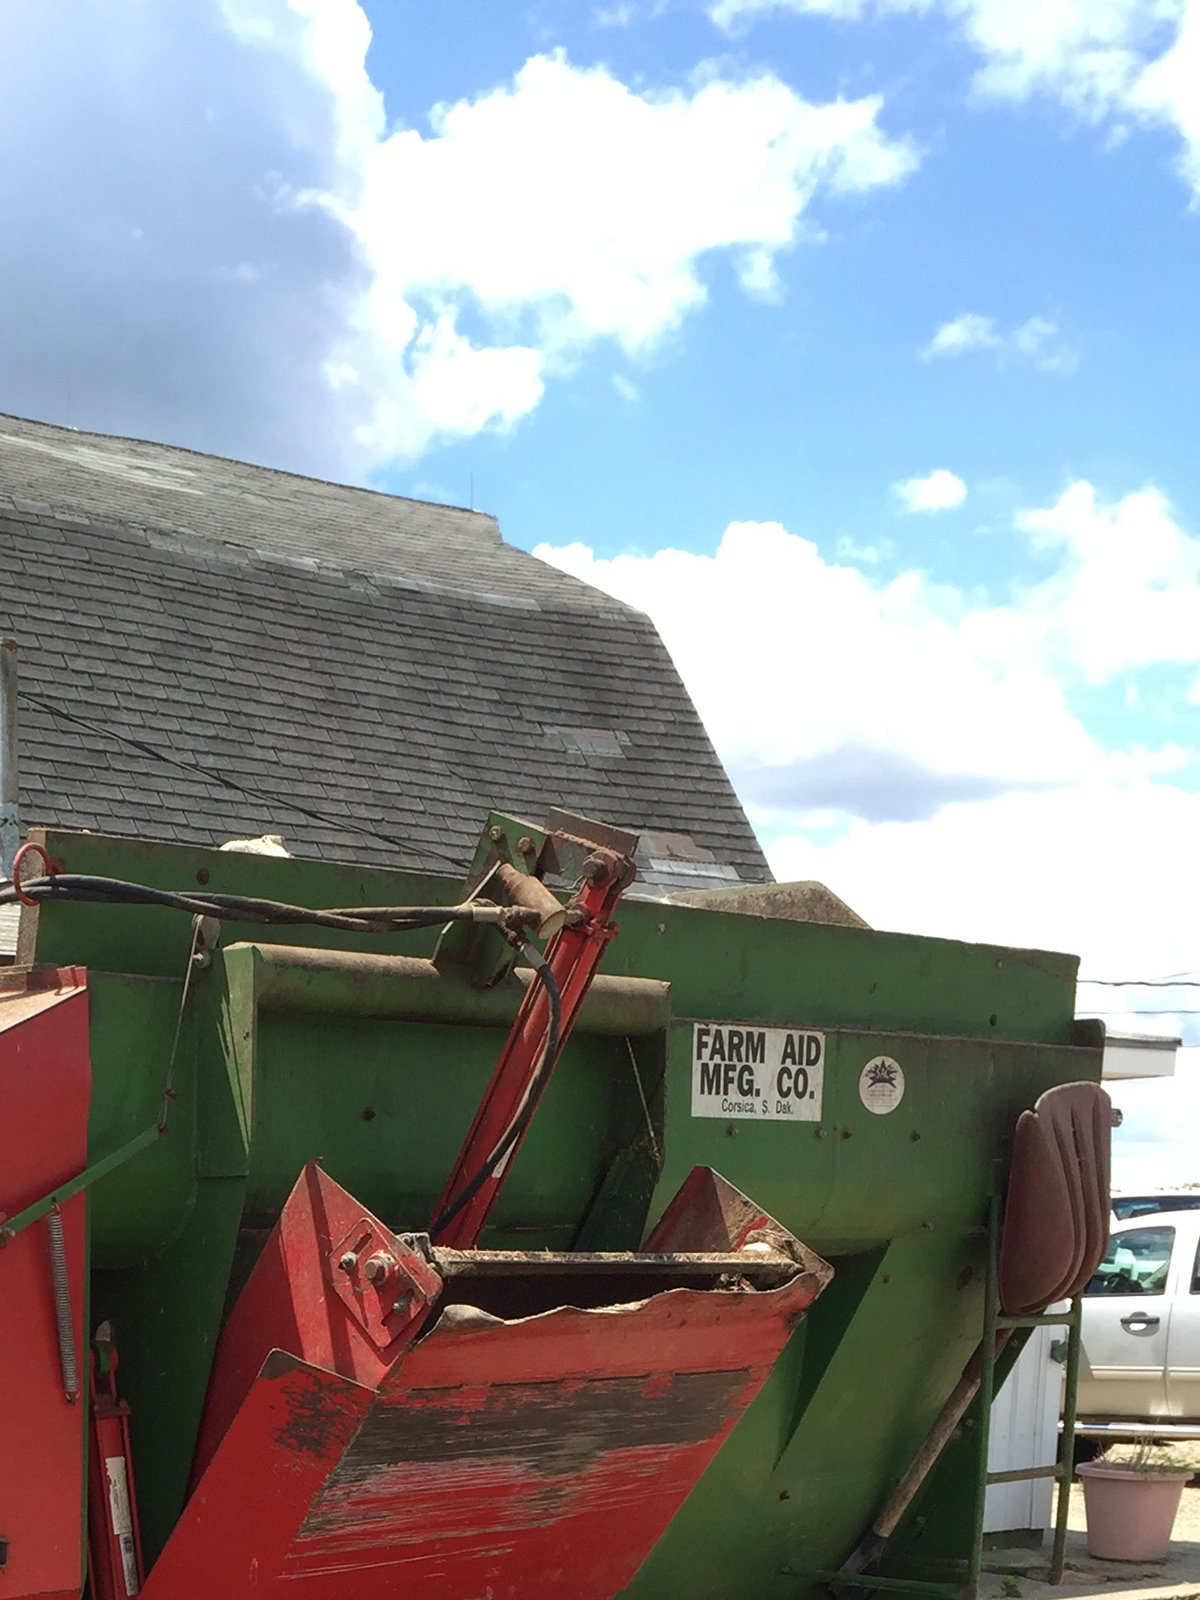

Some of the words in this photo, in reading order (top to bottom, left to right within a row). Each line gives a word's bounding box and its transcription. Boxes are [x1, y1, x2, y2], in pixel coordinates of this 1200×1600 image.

[696, 1028, 766, 1064] FARM
[781, 1034, 822, 1067] AID
[699, 1062, 761, 1098] MFG.
[776, 1066, 816, 1100] CO.
[721, 1098, 757, 1115] Corsica,
[762, 1100, 771, 1116] S.
[776, 1100, 795, 1115] Dak.
